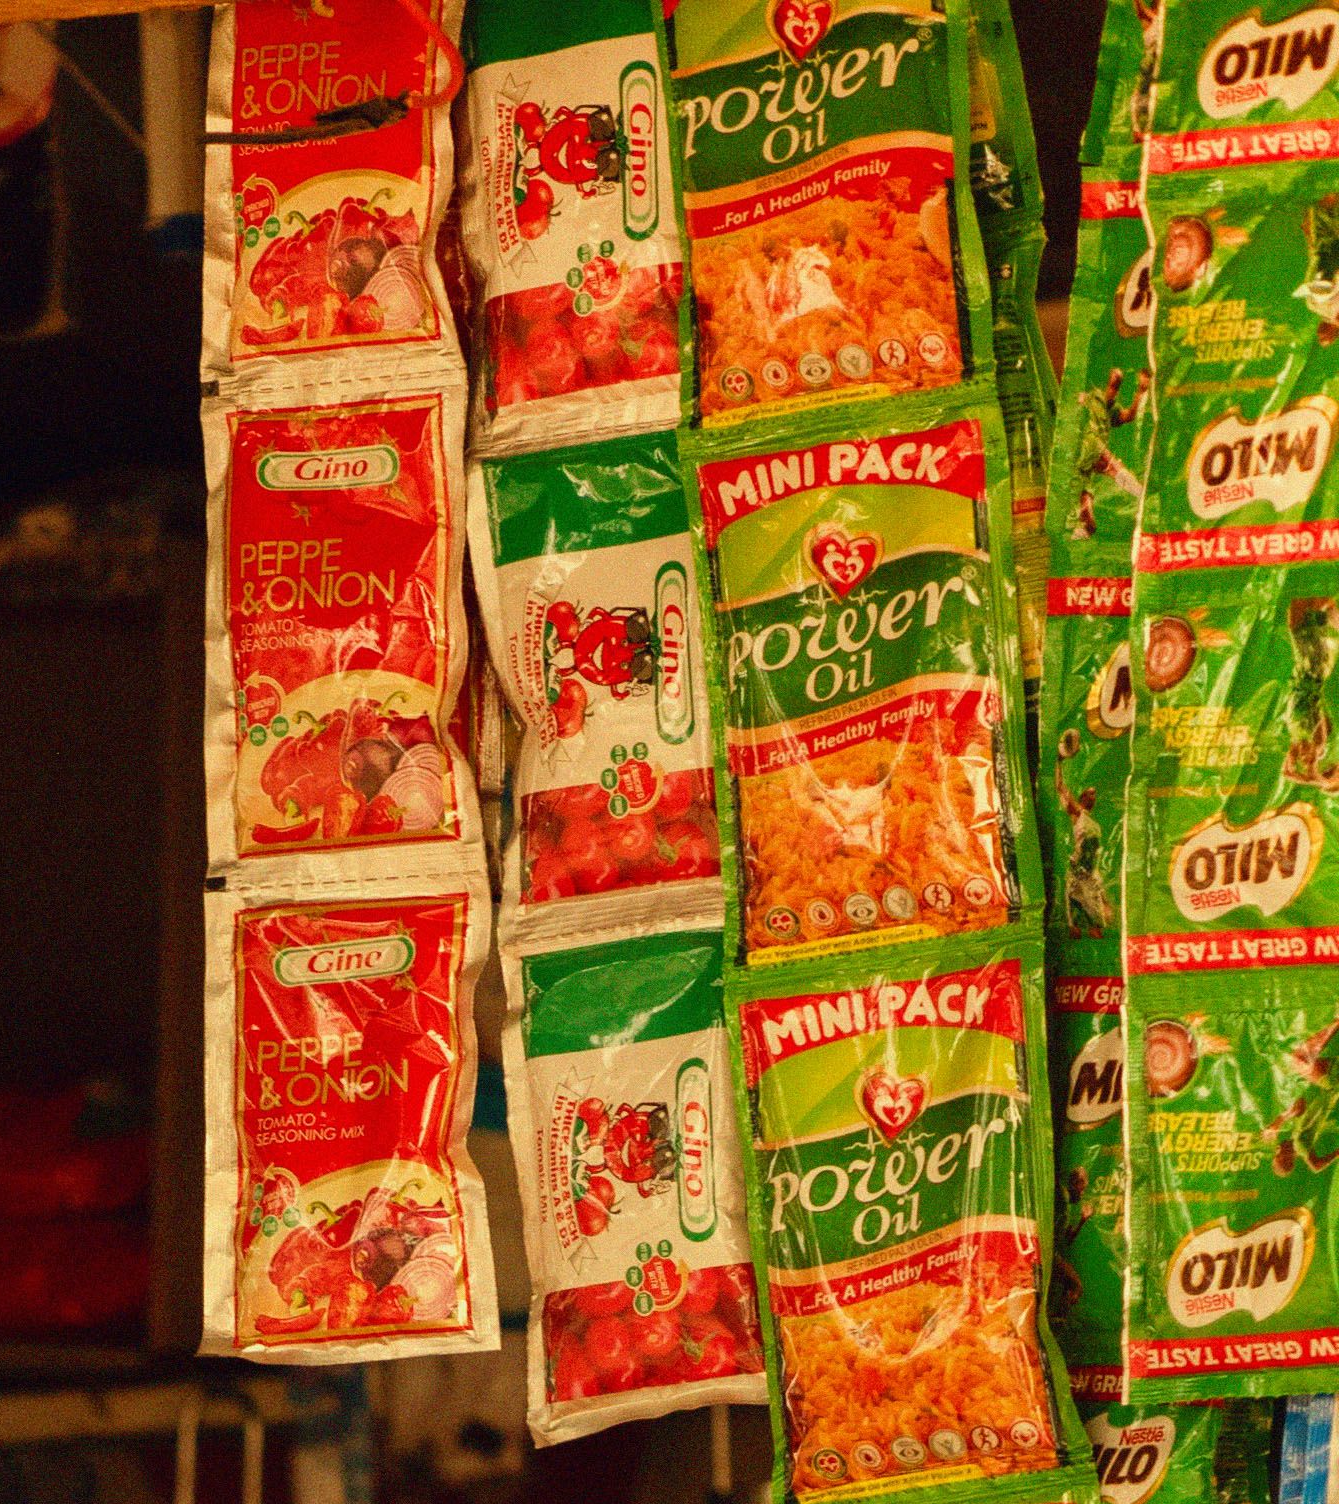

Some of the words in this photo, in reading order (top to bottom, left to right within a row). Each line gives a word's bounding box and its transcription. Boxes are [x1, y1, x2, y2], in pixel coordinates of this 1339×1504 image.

[240, 40, 341, 82] PEPPE
[1213, 24, 1335, 86] MILO
[240, 85, 261, 119] &
[266, 70, 387, 115] ONION
[629, 103, 654, 197] Gino
[763, 108, 828, 164] Oil
[1171, 137, 1243, 161] TASTE
[1249, 129, 1332, 156] GREAT
[753, 203, 764, 218] A
[769, 178, 831, 212] Healthy
[834, 159, 891, 185] Family
[294, 457, 369, 481] Gino
[718, 451, 816, 517] MINI
[829, 442, 948, 484] PACK
[1201, 425, 1319, 487] MILO
[240, 538, 343, 579] PEPPE
[1160, 537, 1230, 563] TASTE
[1236, 531, 1314, 557] GREAT
[241, 582, 261, 617] &
[266, 569, 396, 613] ONION
[1065, 586, 1117, 608] NEW
[241, 618, 294, 635] TOMATO
[662, 603, 685, 699] Gino
[805, 648, 875, 703] Oil
[813, 719, 877, 754] Healthy
[881, 700, 936, 729] Family
[1184, 830, 1300, 890] MILO
[1145, 941, 1223, 963] TASTE
[1227, 936, 1308, 958] GREAT
[763, 993, 866, 1056] MINI
[878, 983, 991, 1026] PACK
[257, 1031, 363, 1075] PEPPE
[260, 1076, 281, 1111] &
[287, 1058, 409, 1107] ONION
[256, 1113, 317, 1131] TOMATO
[256, 1126, 337, 1147] SEASONING
[341, 1125, 365, 1140] MIX
[683, 1101, 710, 1197] Gino
[1176, 1150, 1263, 1173] SUPPORTS
[853, 1192, 921, 1246] Oil
[843, 1285, 856, 1299] A
[860, 1261, 922, 1300] Healthy
[926, 1244, 979, 1272] Family
[1180, 1235, 1295, 1297] MILO
[1145, 1346, 1220, 1369] TASTE
[1224, 1340, 1303, 1364] GREAT
